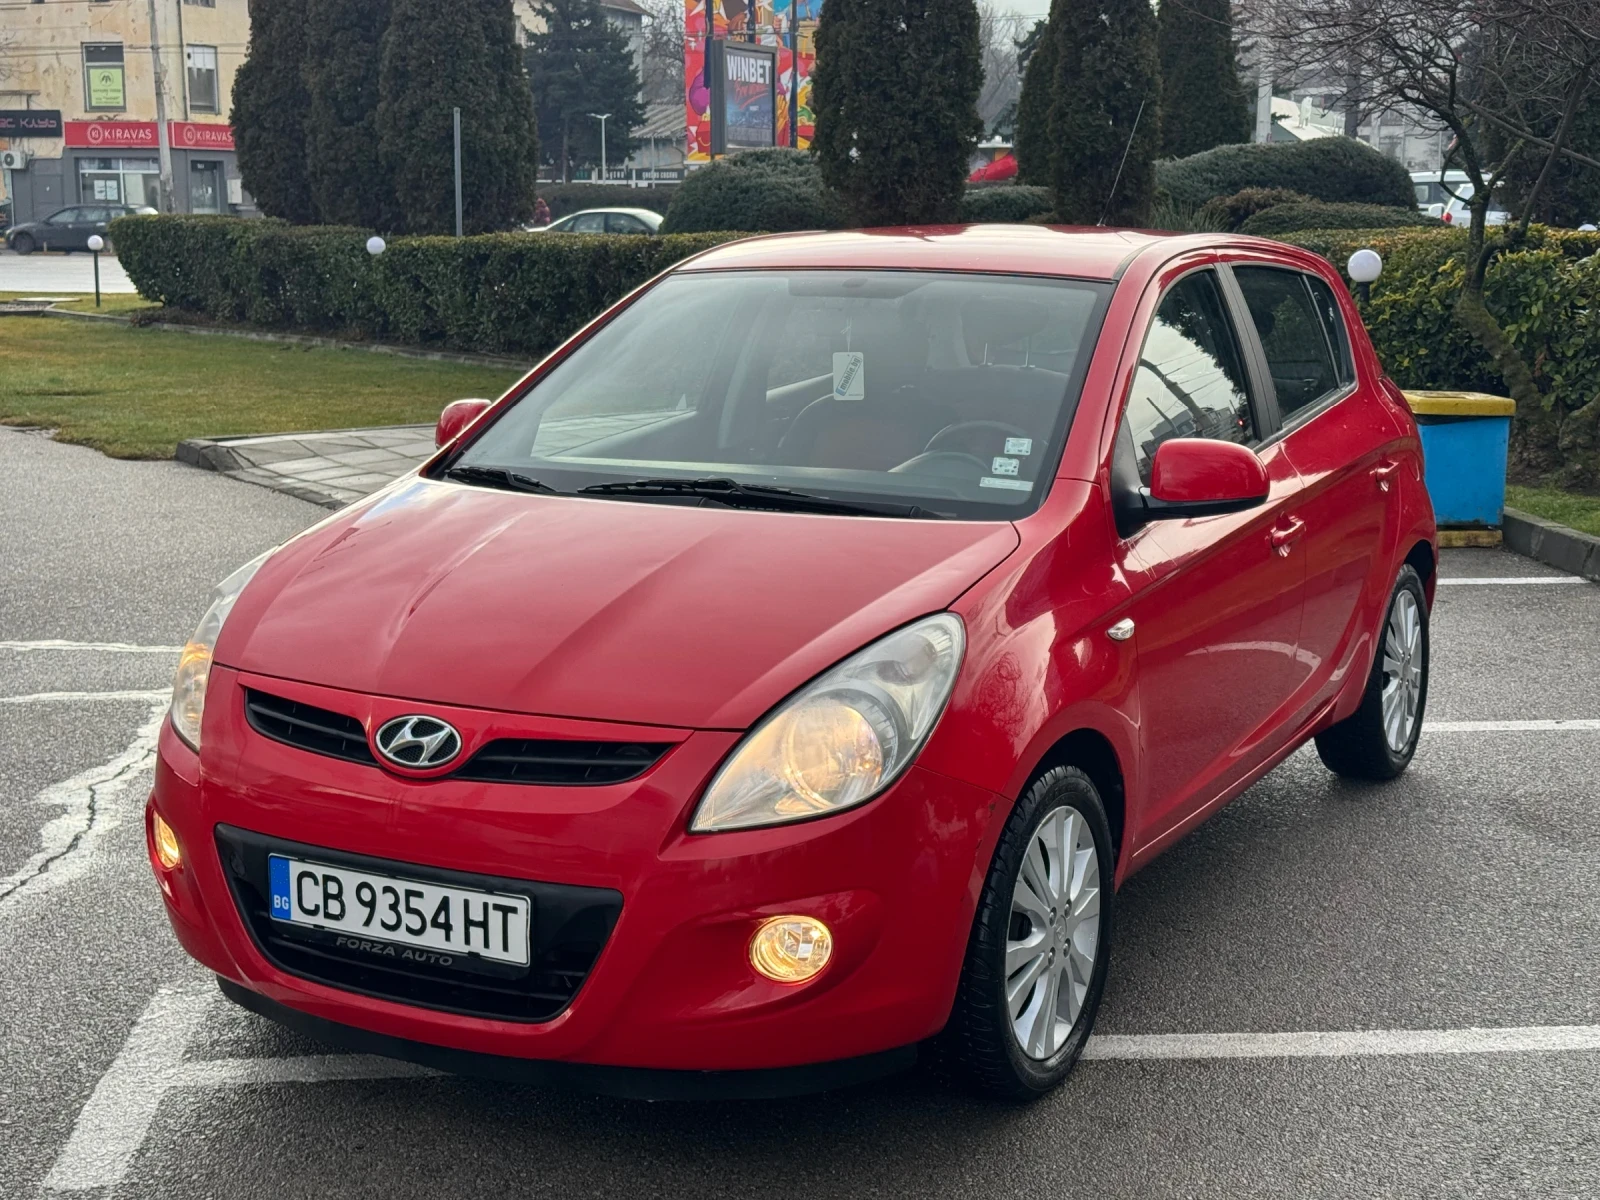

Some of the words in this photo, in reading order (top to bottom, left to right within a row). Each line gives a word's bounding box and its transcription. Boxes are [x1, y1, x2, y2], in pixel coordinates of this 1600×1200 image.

[727, 55, 772, 84] WINBET
[104, 128, 152, 140] KIRAVAS
[197, 130, 233, 143] KIRAVAS
[273, 894, 290, 911] BG
[296, 870, 347, 922] CB
[355, 881, 453, 943] 9354
[463, 898, 518, 953] HT
[336, 936, 396, 957] FORZA
[401, 949, 453, 966] AUTO
